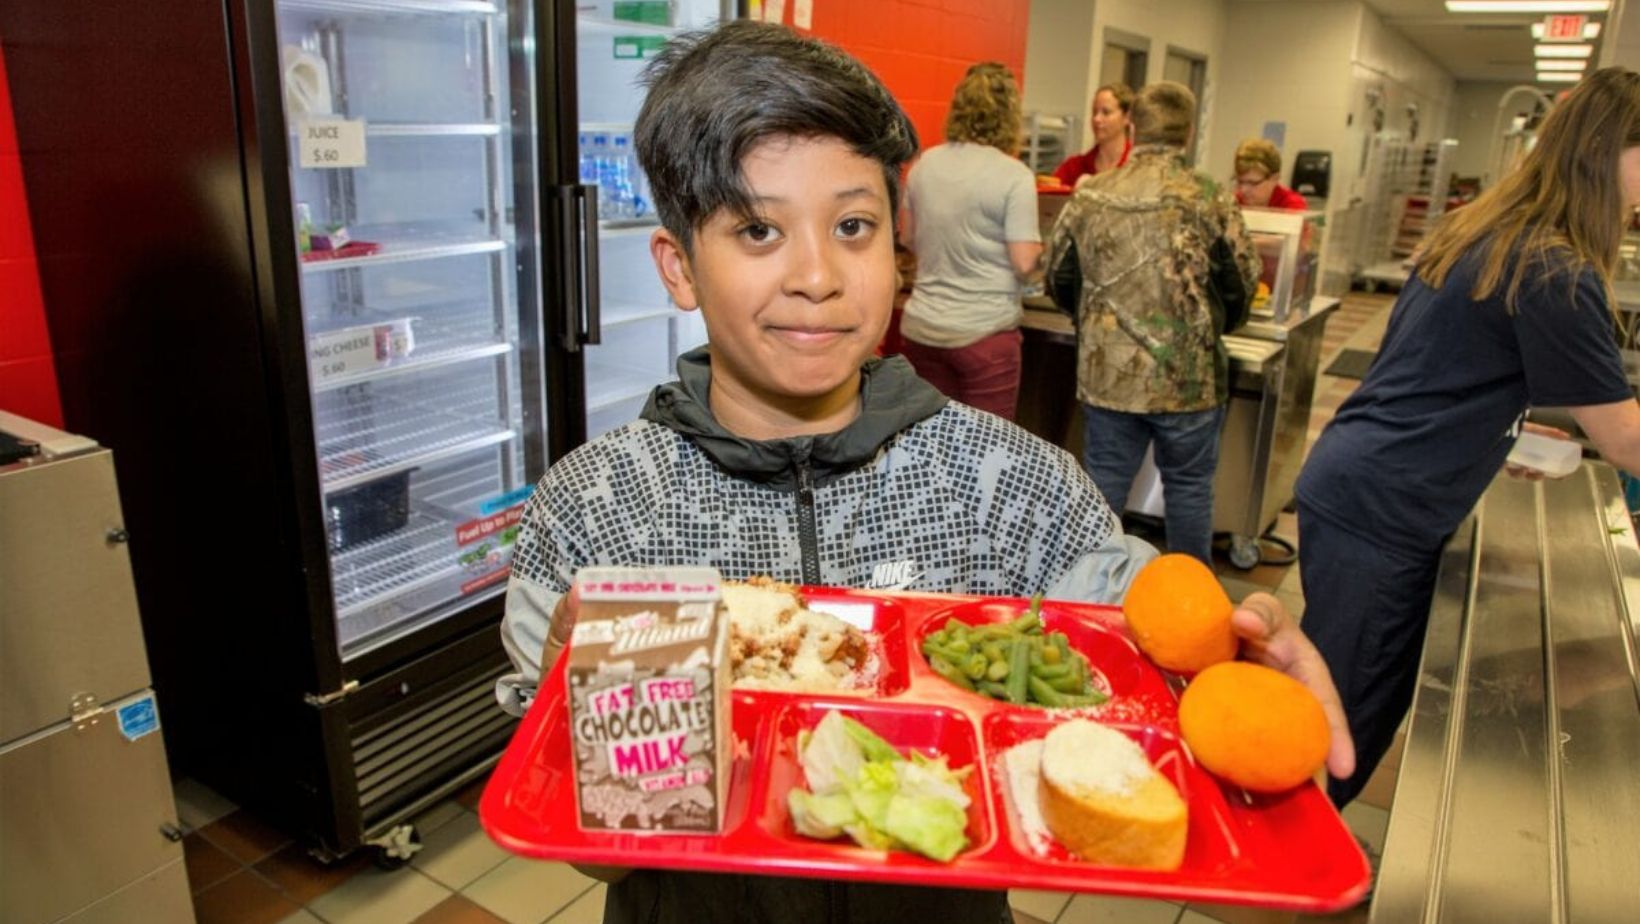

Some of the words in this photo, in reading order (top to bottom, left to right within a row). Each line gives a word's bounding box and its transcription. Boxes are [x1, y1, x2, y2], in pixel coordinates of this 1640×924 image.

[1551, 15, 1580, 37] EXIT
[308, 126, 339, 139] JUICE
[313, 148, 339, 162] $.60
[333, 336, 370, 354] CHEESE
[459, 525, 480, 543] Fuel
[480, 520, 495, 533] Up
[495, 516, 505, 527] to
[871, 561, 914, 587] NIKE
[594, 687, 635, 717] FAT
[647, 681, 695, 703] FREE
[580, 701, 707, 742] CHOCOLATE
[613, 735, 690, 775] MILK
